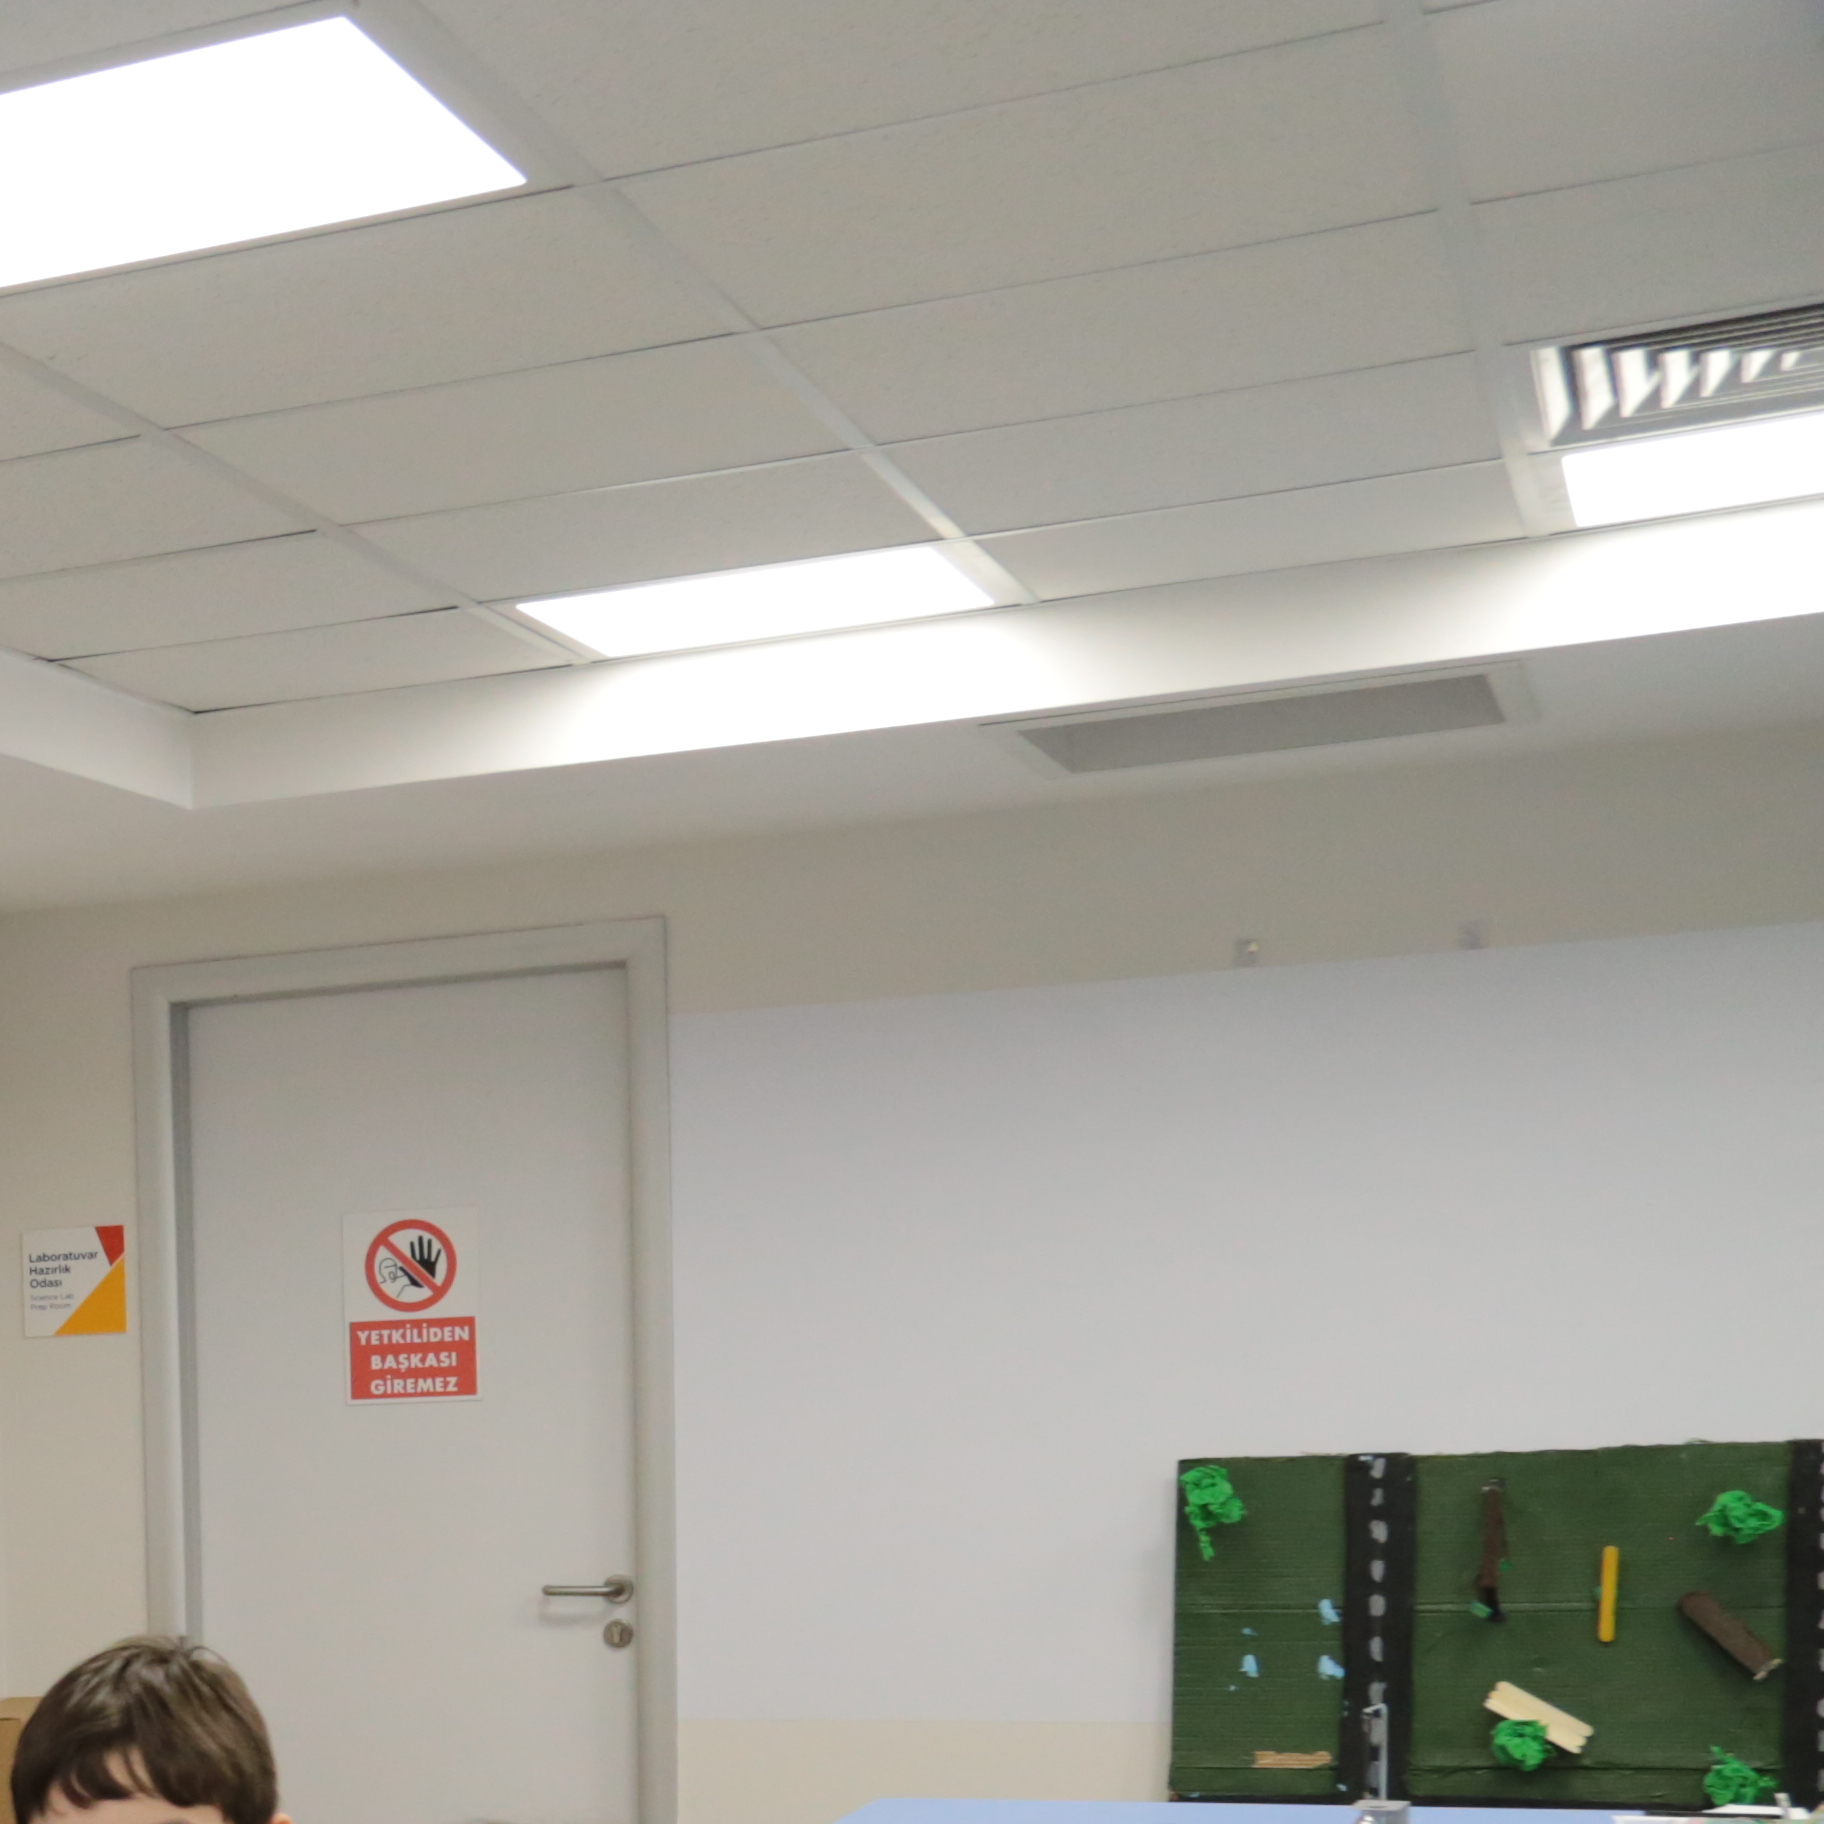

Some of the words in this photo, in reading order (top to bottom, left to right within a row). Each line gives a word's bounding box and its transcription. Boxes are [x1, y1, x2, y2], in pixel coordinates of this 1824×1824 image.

[29, 1251, 98, 1263] Laboratuvar
[356, 1323, 470, 1345] YETKİLİDEN
[370, 1351, 457, 1372] BAŞKASI
[370, 1375, 458, 1395] GİREMEZ
